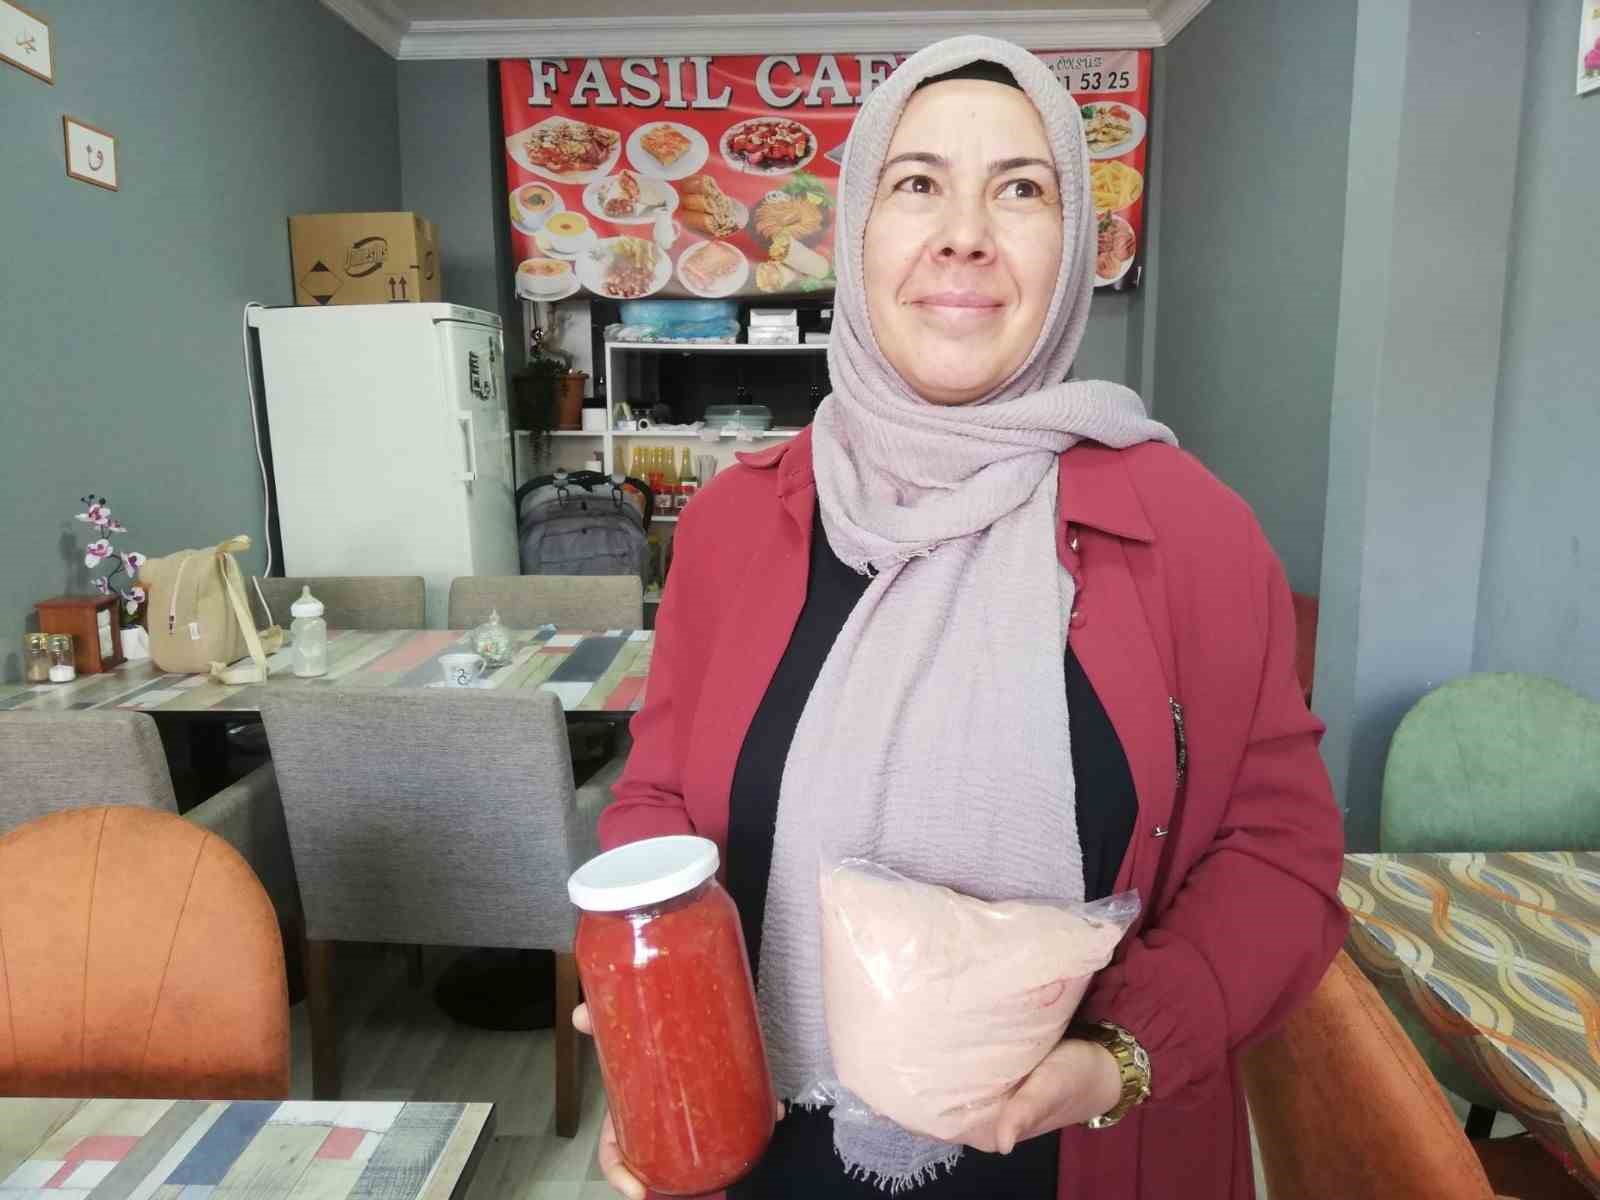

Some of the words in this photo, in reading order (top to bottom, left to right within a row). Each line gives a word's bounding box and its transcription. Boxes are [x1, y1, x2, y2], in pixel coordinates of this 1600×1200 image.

[528, 56, 732, 108] FASIL
[755, 54, 908, 107] CAF
[1080, 72, 1102, 90] 53
[1108, 71, 1130, 89] 25
